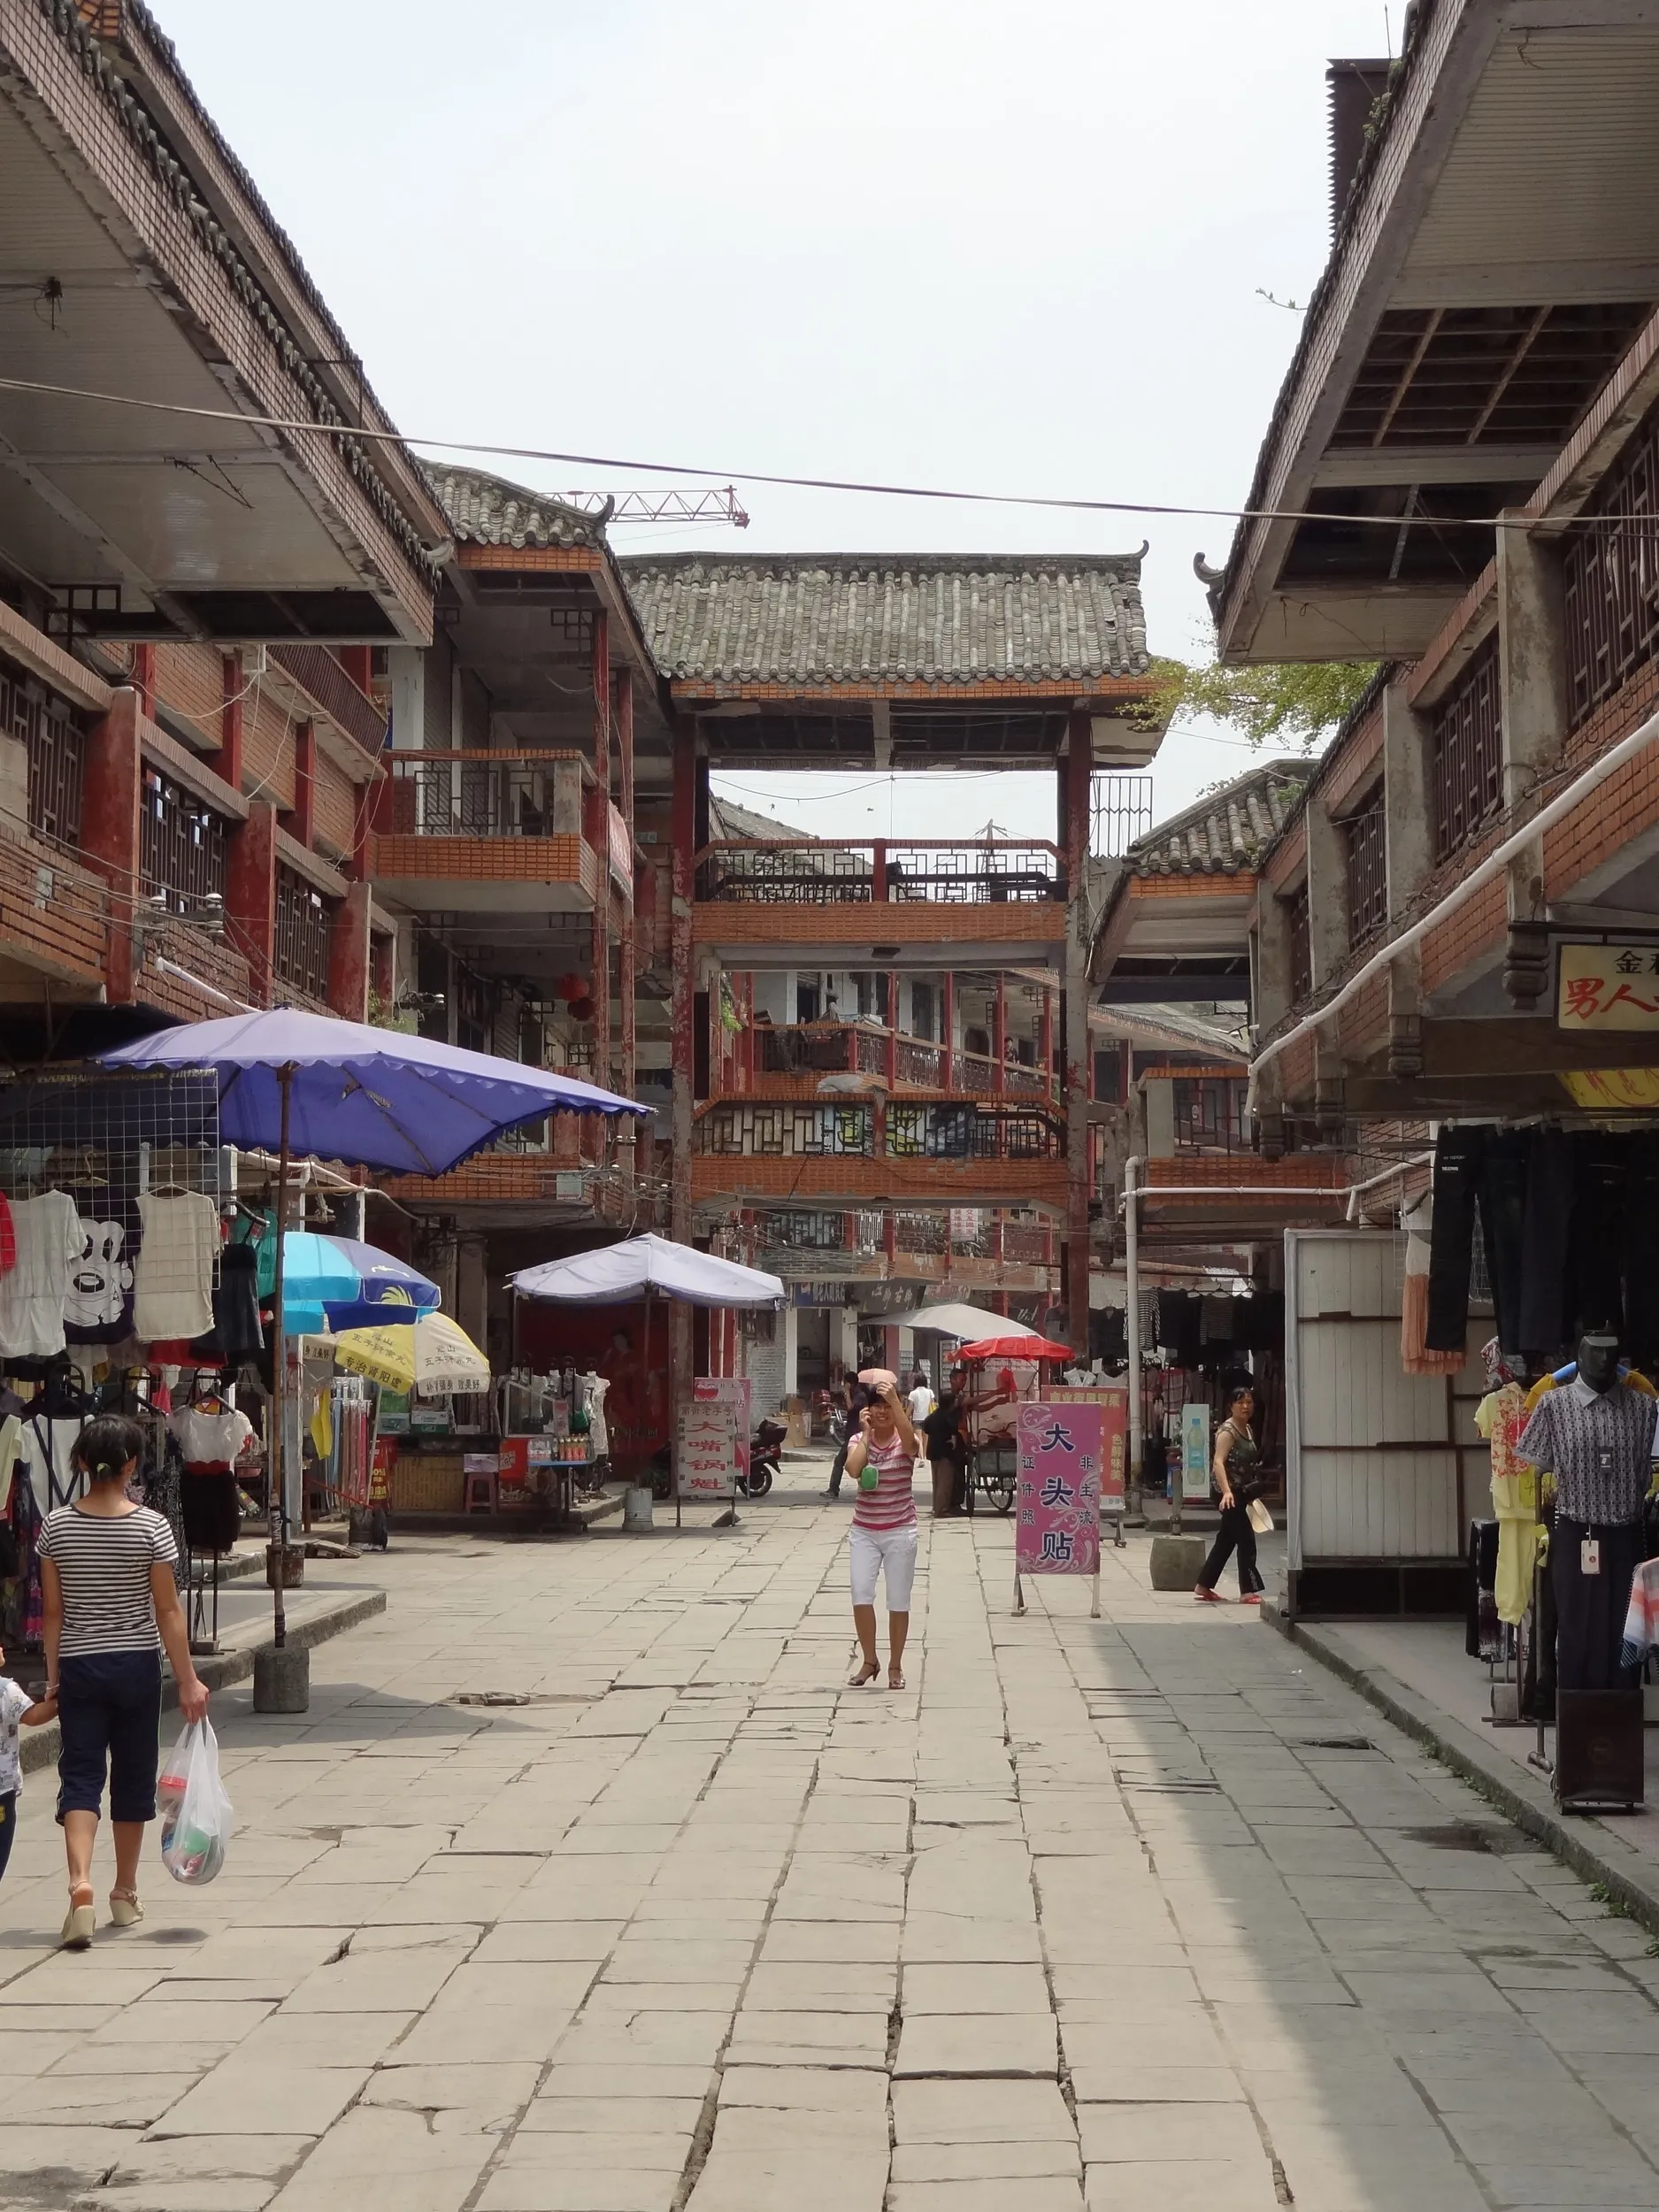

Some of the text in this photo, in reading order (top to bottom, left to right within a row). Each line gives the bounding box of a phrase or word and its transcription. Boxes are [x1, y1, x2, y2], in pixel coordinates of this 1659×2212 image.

[1563, 977, 1659, 1020] 男人
[346, 1356, 402, 1388] 专治肾阳虚
[686, 1421, 727, 1491] 大嘴锅魁
[1021, 1455, 1035, 1524] 证件照
[1079, 1455, 1094, 1525] 非主流
[1041, 1423, 1074, 1562] 大头贴
